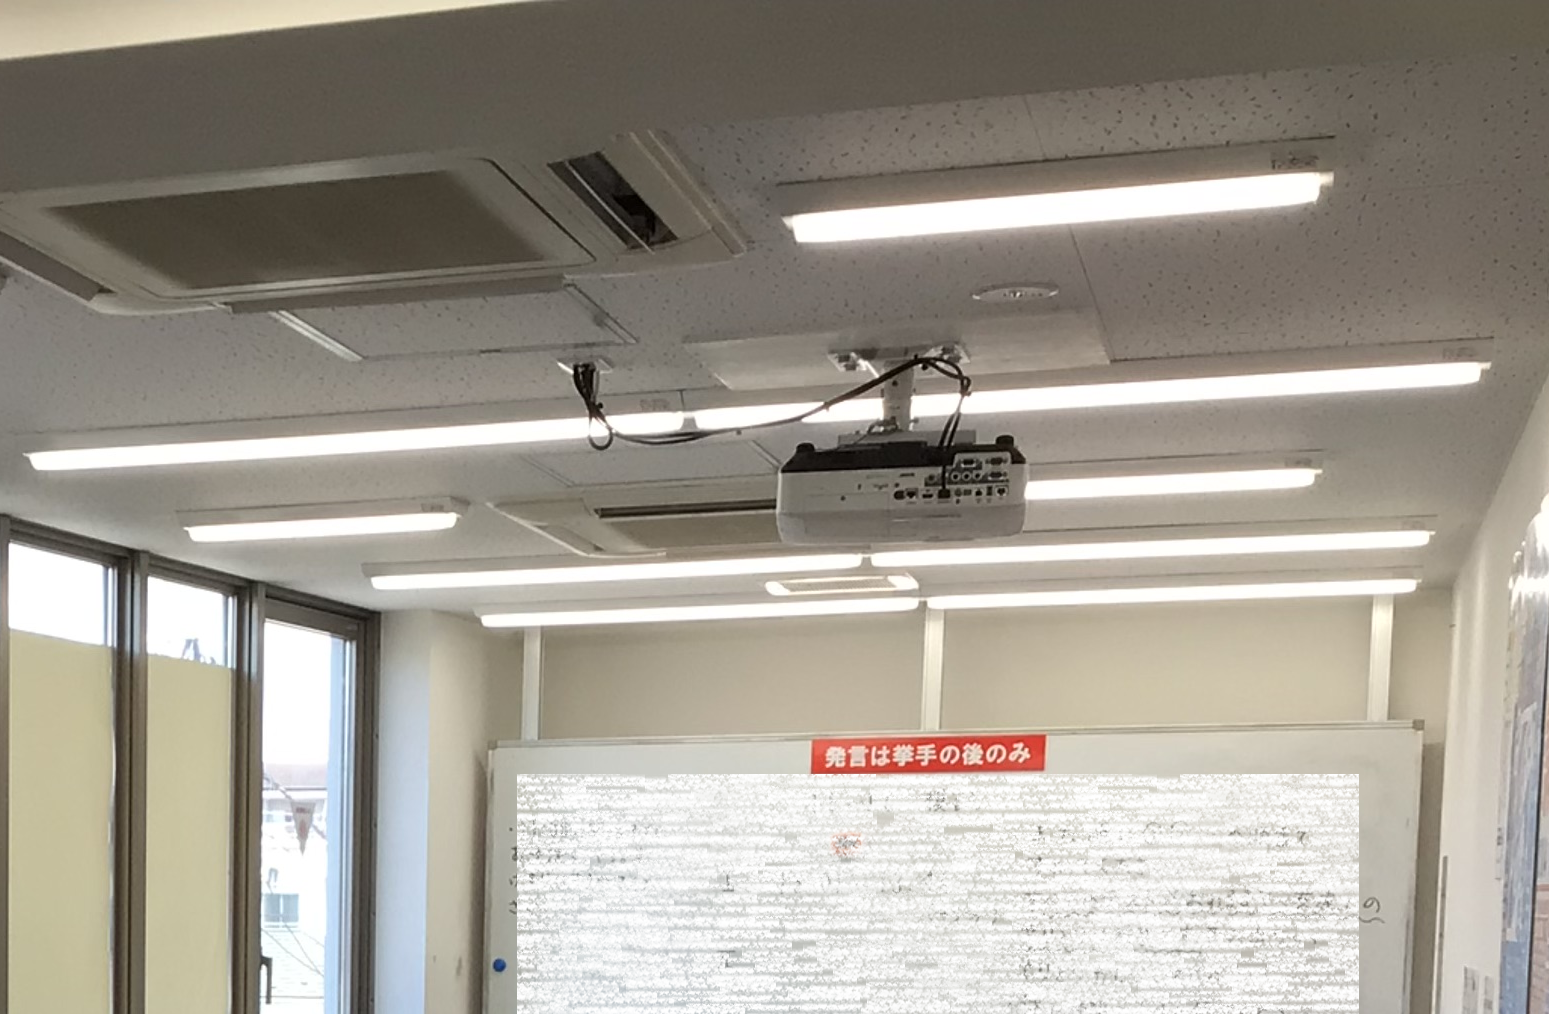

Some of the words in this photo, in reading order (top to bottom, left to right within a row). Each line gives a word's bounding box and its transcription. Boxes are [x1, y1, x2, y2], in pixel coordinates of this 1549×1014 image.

[825, 742, 1031, 769] 発言は挙手の後のみ
